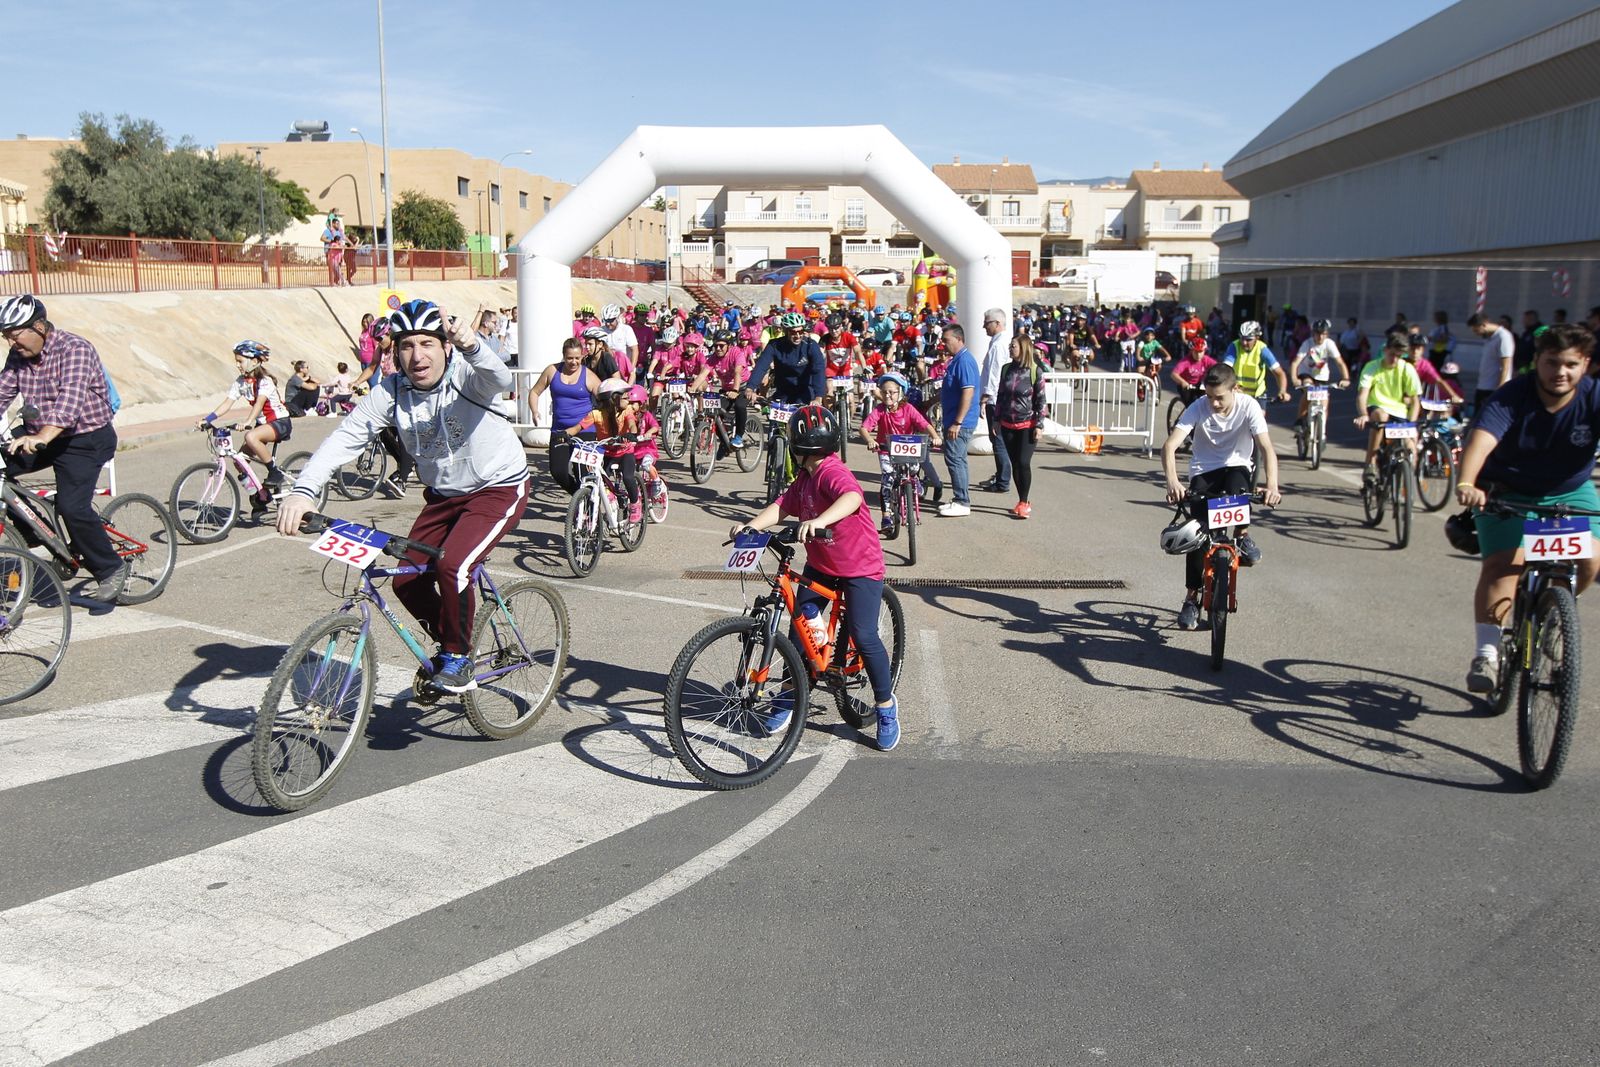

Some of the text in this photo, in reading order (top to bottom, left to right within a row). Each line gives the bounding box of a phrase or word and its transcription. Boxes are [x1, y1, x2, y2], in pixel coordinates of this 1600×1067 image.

[575, 450, 598, 465] 413
[894, 444, 917, 455] 096
[1212, 508, 1244, 525] 496
[318, 535, 369, 564] 352
[1531, 536, 1582, 556] 445
[727, 550, 757, 568] 069
